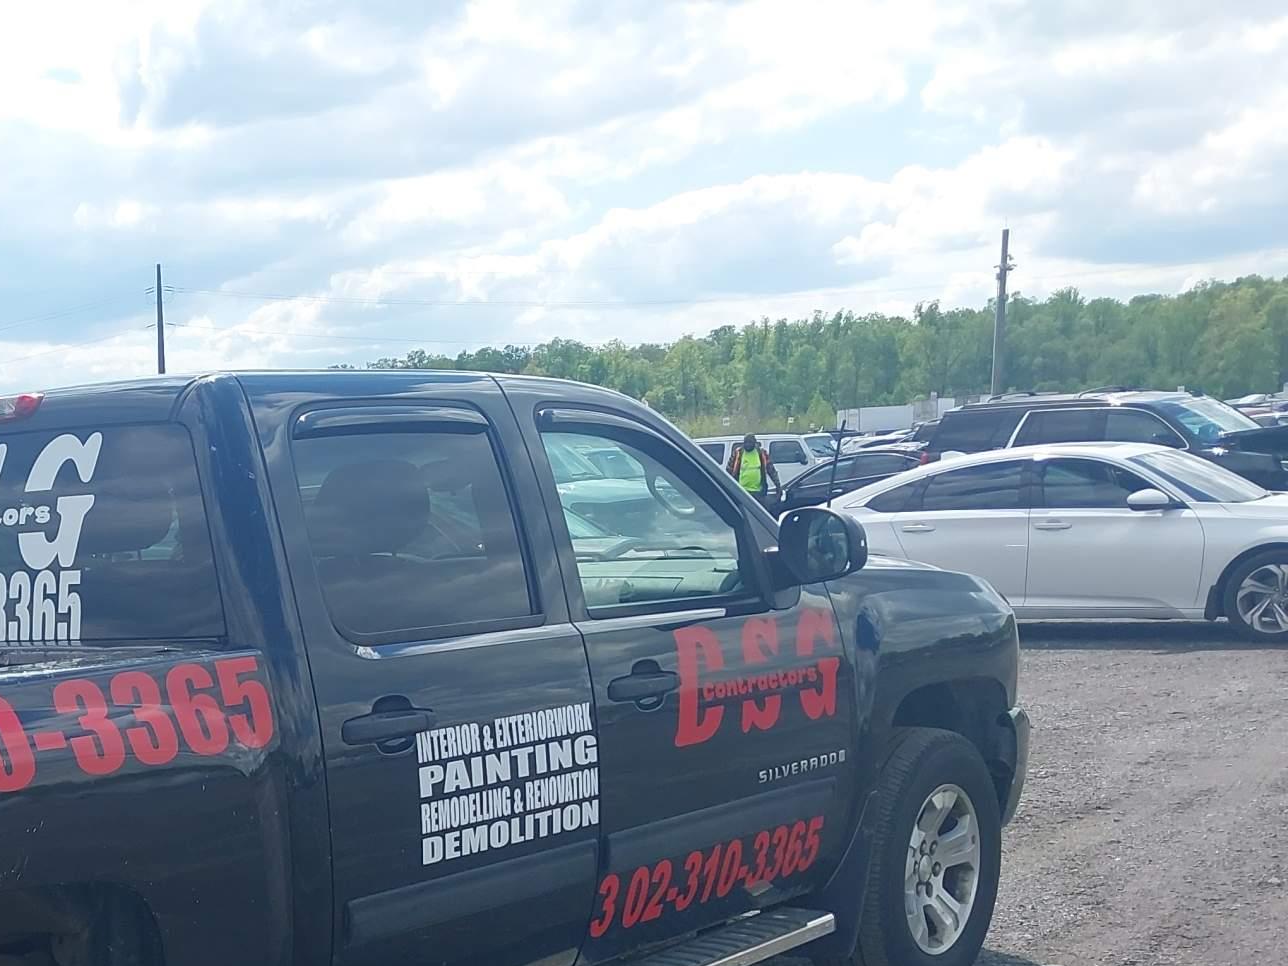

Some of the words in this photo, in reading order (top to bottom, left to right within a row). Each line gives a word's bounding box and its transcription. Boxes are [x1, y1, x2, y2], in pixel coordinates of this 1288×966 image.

[415, 722, 481, 764] INTERIOR
[482, 724, 494, 750] &
[494, 702, 593, 748] EXTERIORWORK
[418, 734, 598, 798] PAINTING
[758, 749, 846, 784] SILVERADO
[420, 766, 511, 835] REMODELLING
[513, 788, 524, 814] &
[525, 767, 600, 811] RENOVATION
[422, 799, 599, 866] DEMOLITION
